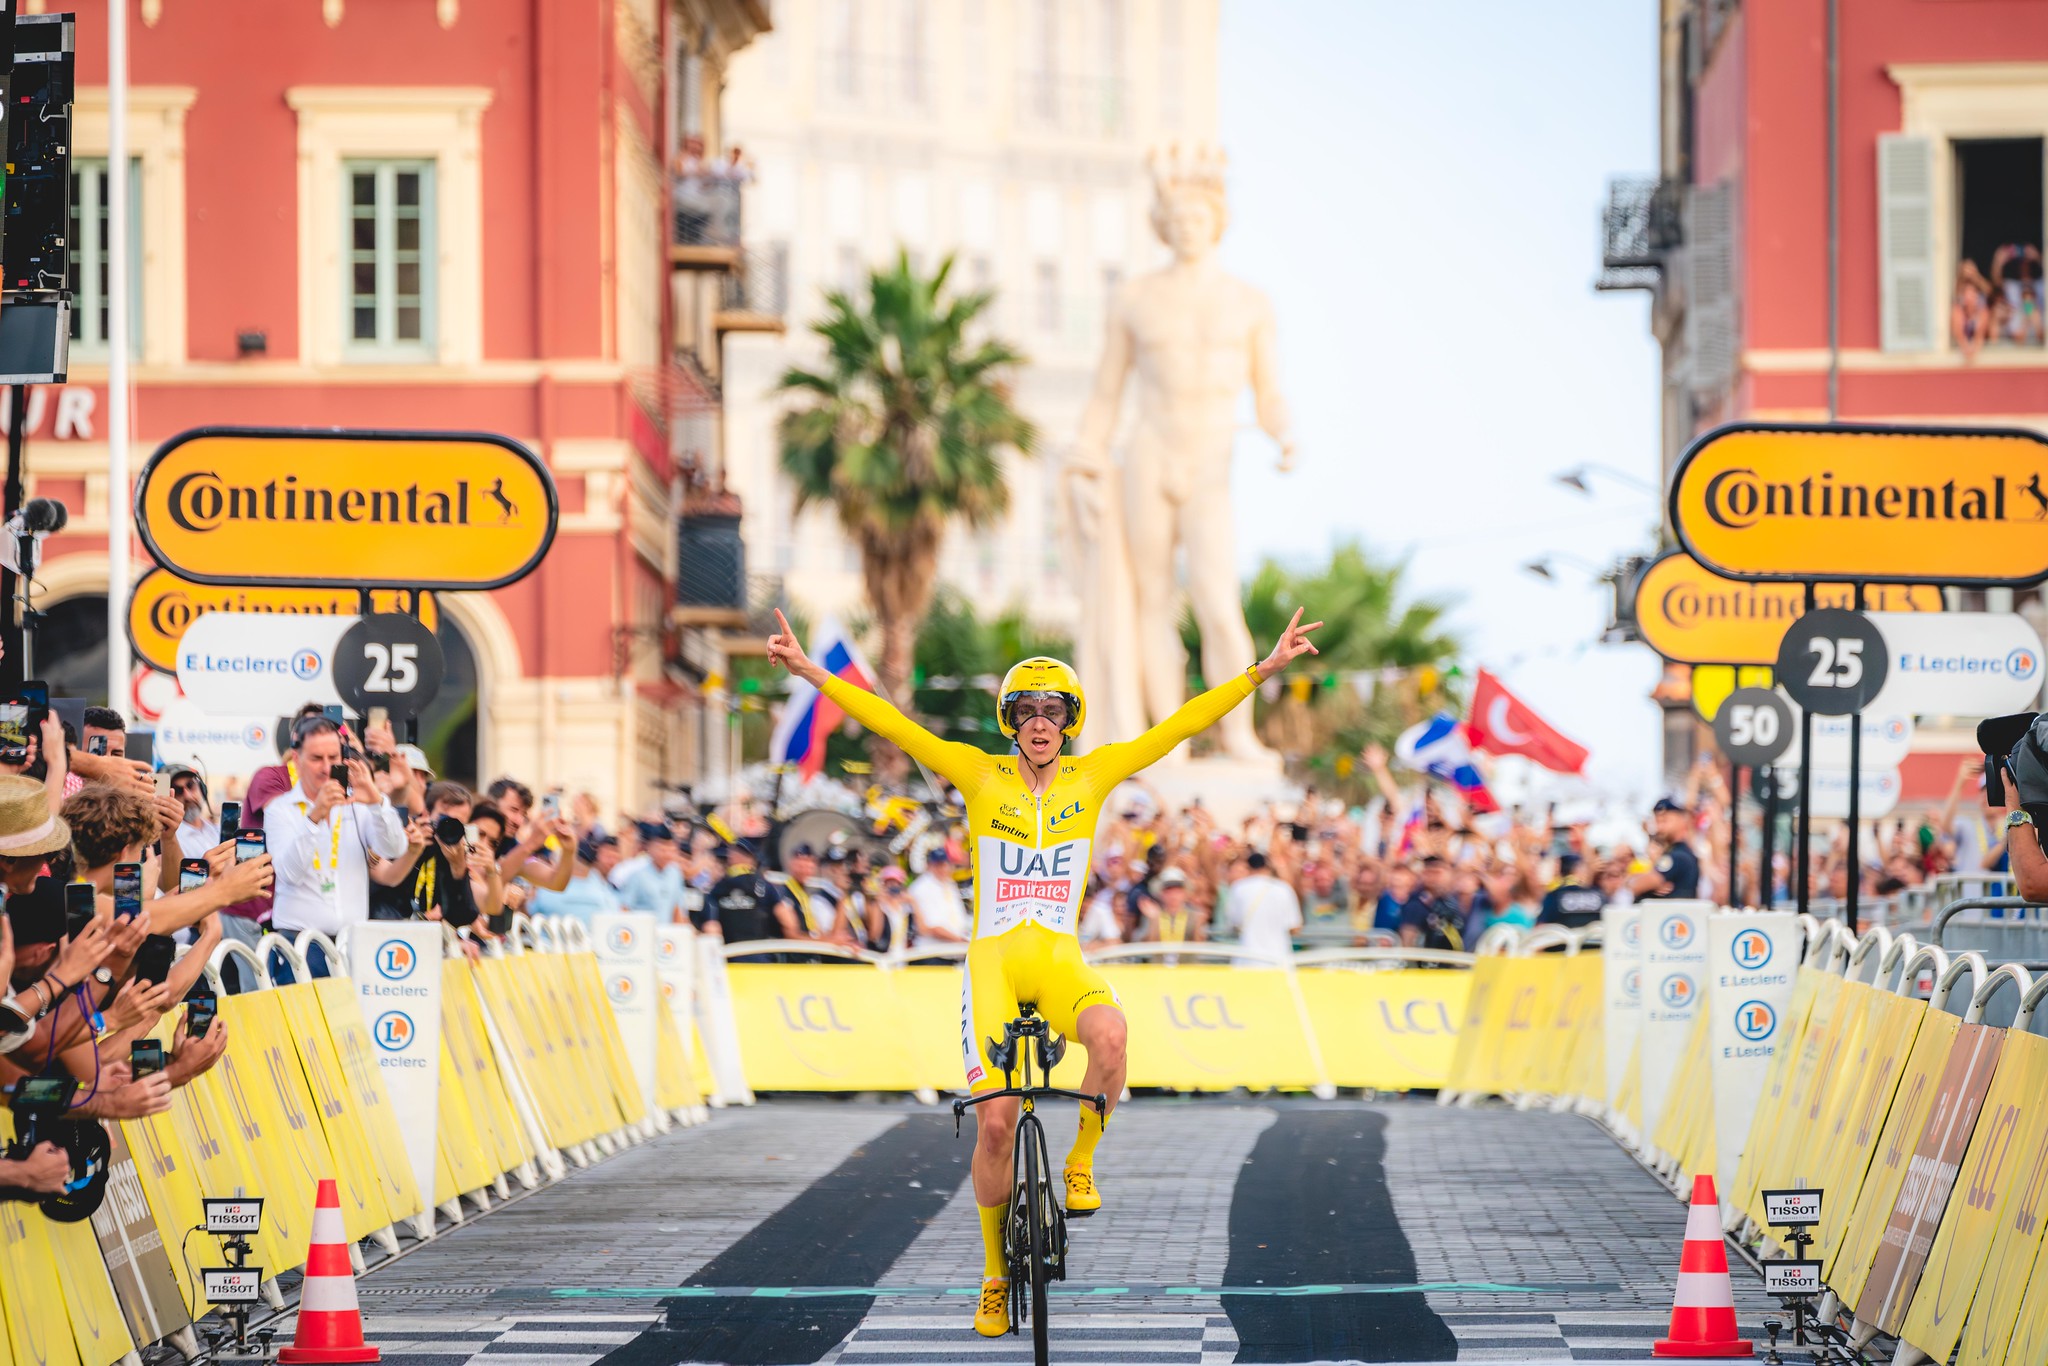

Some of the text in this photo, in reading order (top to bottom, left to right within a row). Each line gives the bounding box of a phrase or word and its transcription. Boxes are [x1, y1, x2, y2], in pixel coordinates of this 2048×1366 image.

[168, 471, 468, 532] Continental
[1705, 468, 2006, 528] Continental
[186, 654, 288, 673] E.Leclerc
[363, 643, 418, 693] 25
[1807, 637, 1864, 689] 25
[1900, 654, 2002, 674] E.Leclerc
[1729, 704, 1780, 747] 50
[1050, 801, 1085, 826] LCL
[991, 818, 1029, 839] Santini
[1000, 841, 1074, 877] UAE
[998, 880, 1069, 900] Emirates
[362, 984, 428, 997] E.Leclerc
[1720, 974, 1787, 988] E.Leclerc
[776, 994, 853, 1032] LCL
[1162, 994, 1245, 1030] LCL
[1724, 1045, 1775, 1059] E.Lecle
[1968, 1104, 2021, 1212] LCL
[210, 1214, 257, 1224] TISSOT
[1770, 1206, 1818, 1216] TISSOT
[209, 1284, 255, 1294] TISSOT
[1769, 1278, 1815, 1287] TISSOT
